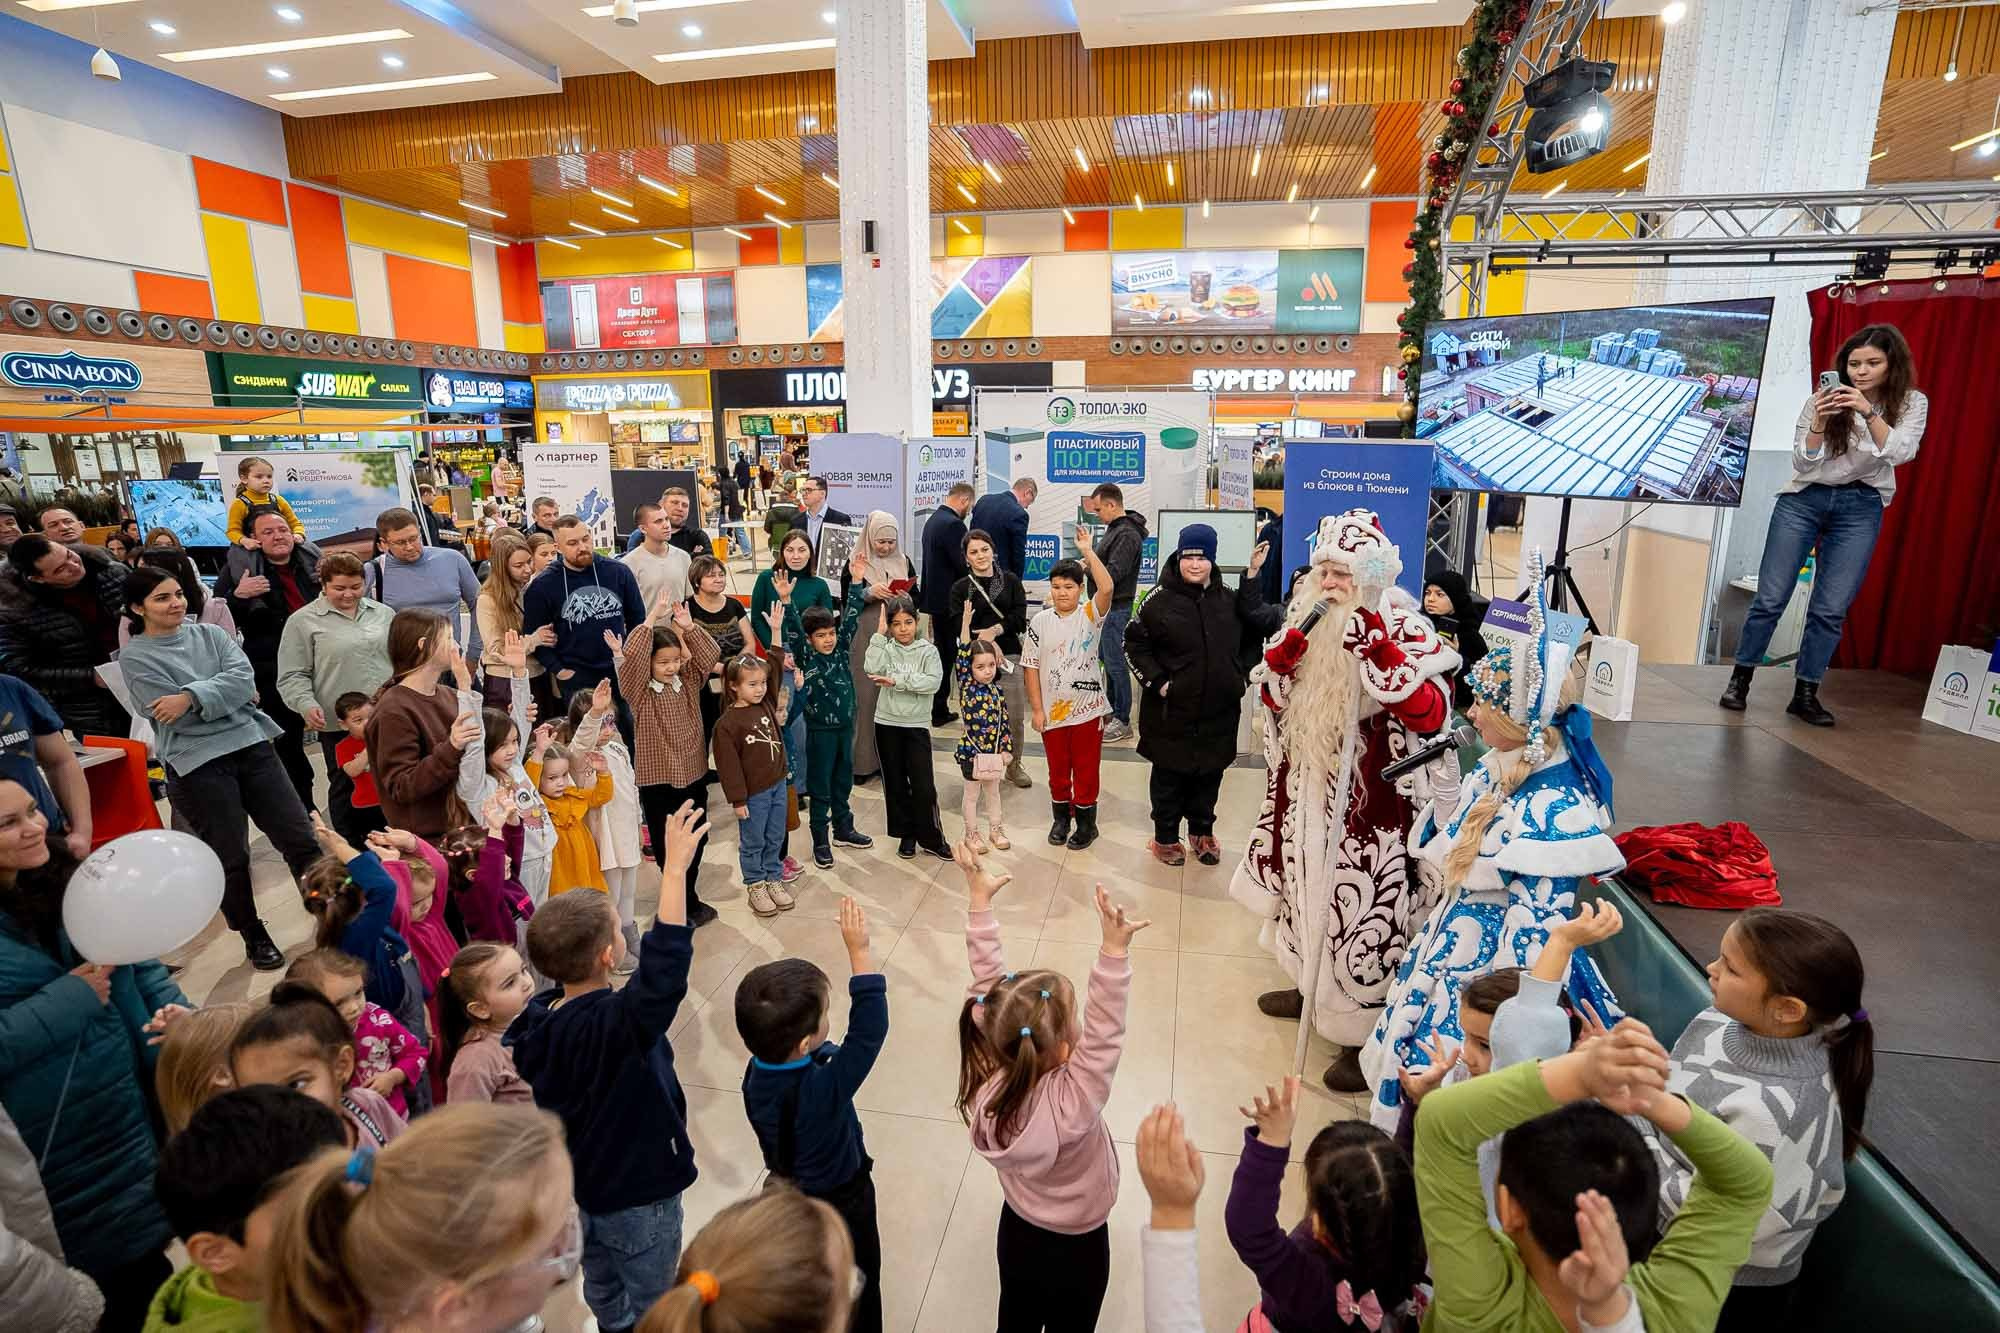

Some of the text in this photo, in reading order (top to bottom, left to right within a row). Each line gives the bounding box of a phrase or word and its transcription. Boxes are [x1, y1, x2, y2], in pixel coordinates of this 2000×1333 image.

[1131, 268, 1173, 284] ВКУСНО
[1470, 330, 1503, 341] СИТИ
[1470, 337, 1511, 351] СТРОЙ
[233, 375, 288, 387] СЭНДВИЧИ
[300, 372, 376, 397] SUBWAY
[931, 369, 970, 399] УЗ
[1192, 369, 1356, 391] БУРГЕР КИНГ
[380, 383, 410, 393] САЛАТЫ
[479, 381, 504, 397] PHO
[1054, 438, 1140, 449] ПЛАСТИКОВЫЙ
[546, 453, 598, 463] партнер
[1054, 450, 1139, 469] ПОГРЕБ
[918, 470, 964, 482] АВТОНОМНАЯ
[1320, 468, 1391, 481] Строим дома
[1303, 482, 1315, 490] из
[1317, 480, 1354, 491] блоков
[1366, 483, 1409, 494] Тюмени
[1025, 550, 1055, 559] ЗАЦИЯ
[1026, 559, 1050, 576] АС
